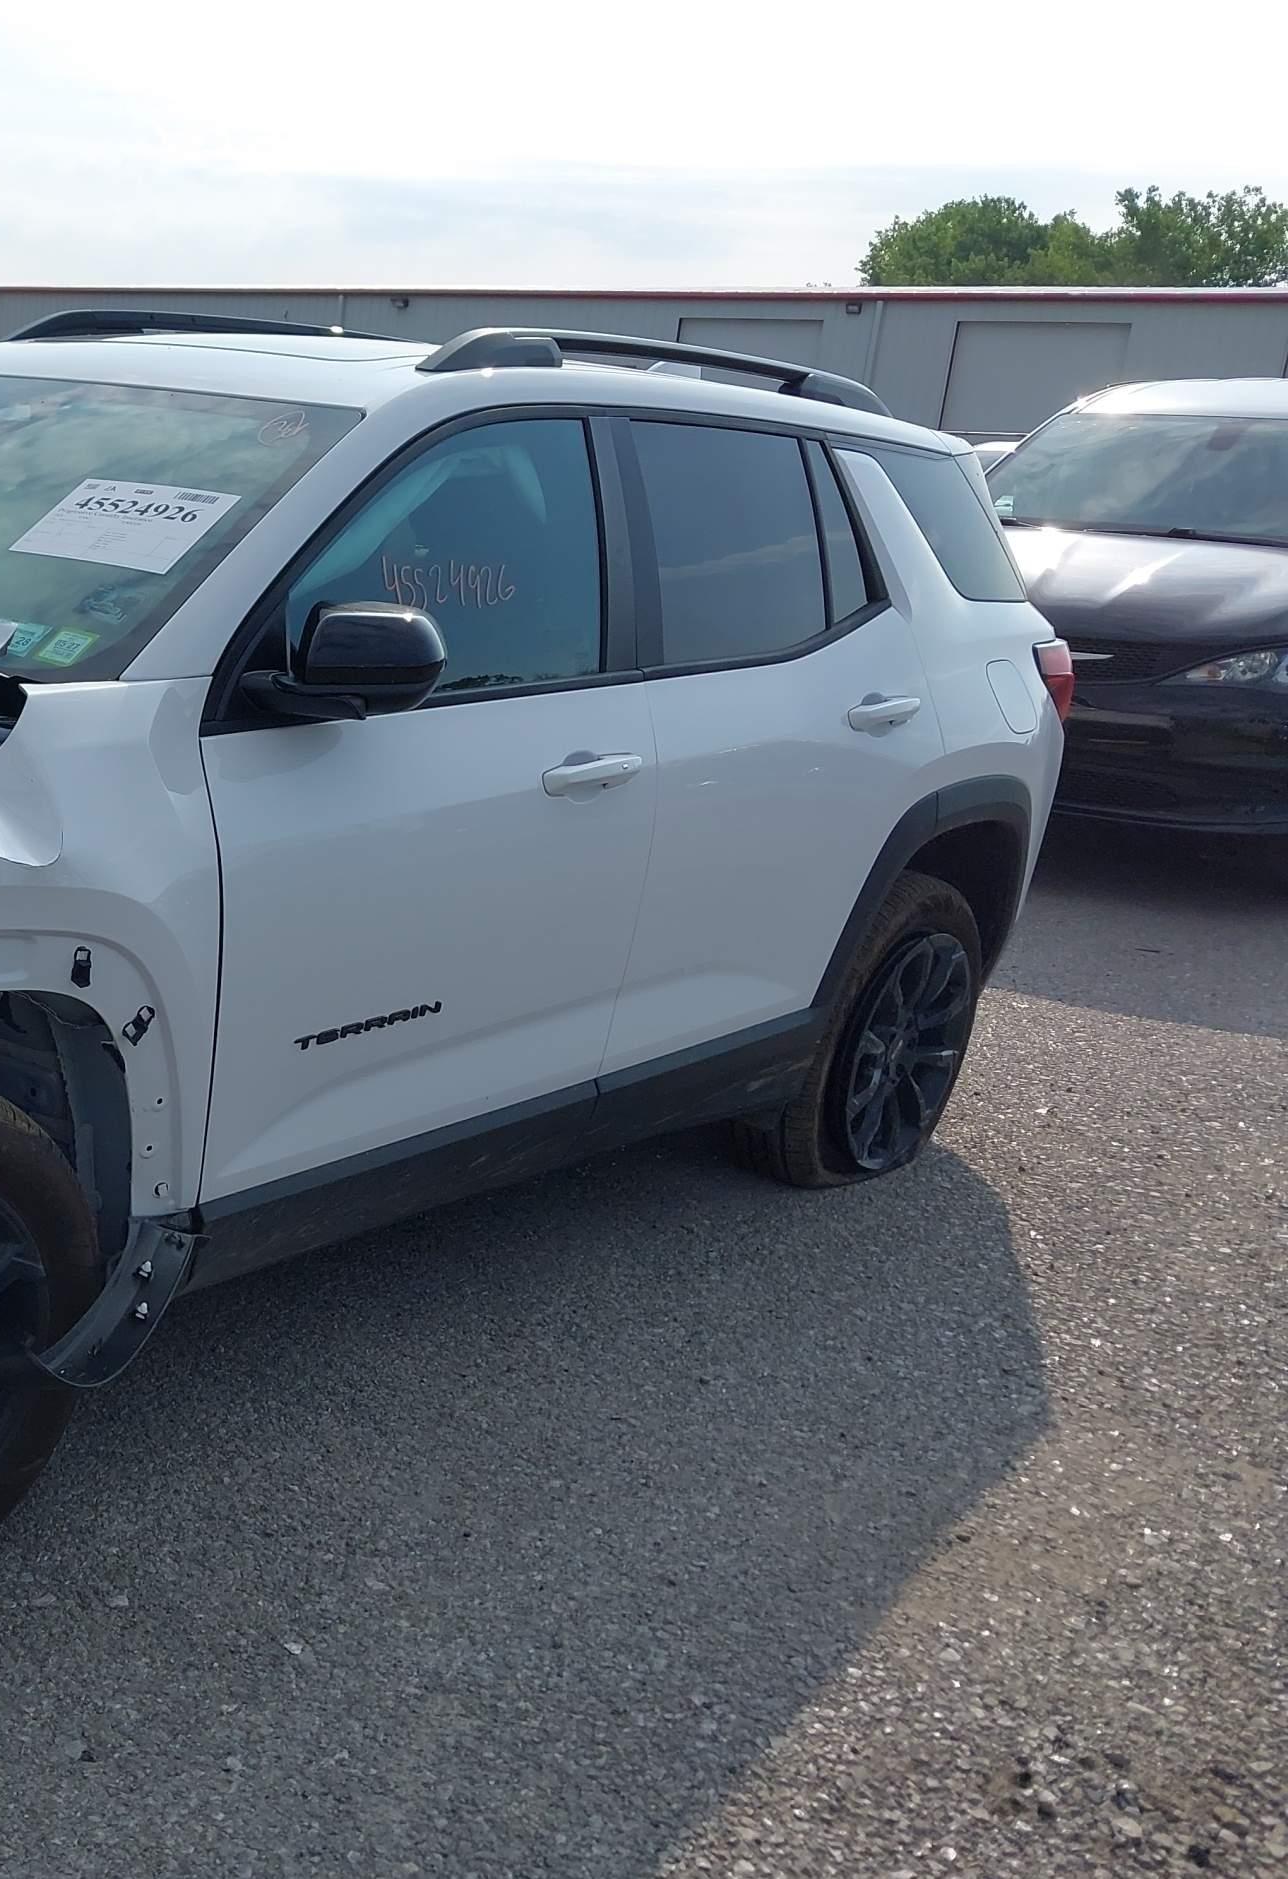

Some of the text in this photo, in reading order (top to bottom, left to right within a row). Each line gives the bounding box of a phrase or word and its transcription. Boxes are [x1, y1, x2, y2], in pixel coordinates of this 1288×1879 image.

[74, 495, 205, 523] 45524926
[380, 555, 517, 610] 45524926
[293, 1000, 443, 1051] TERRAIN
